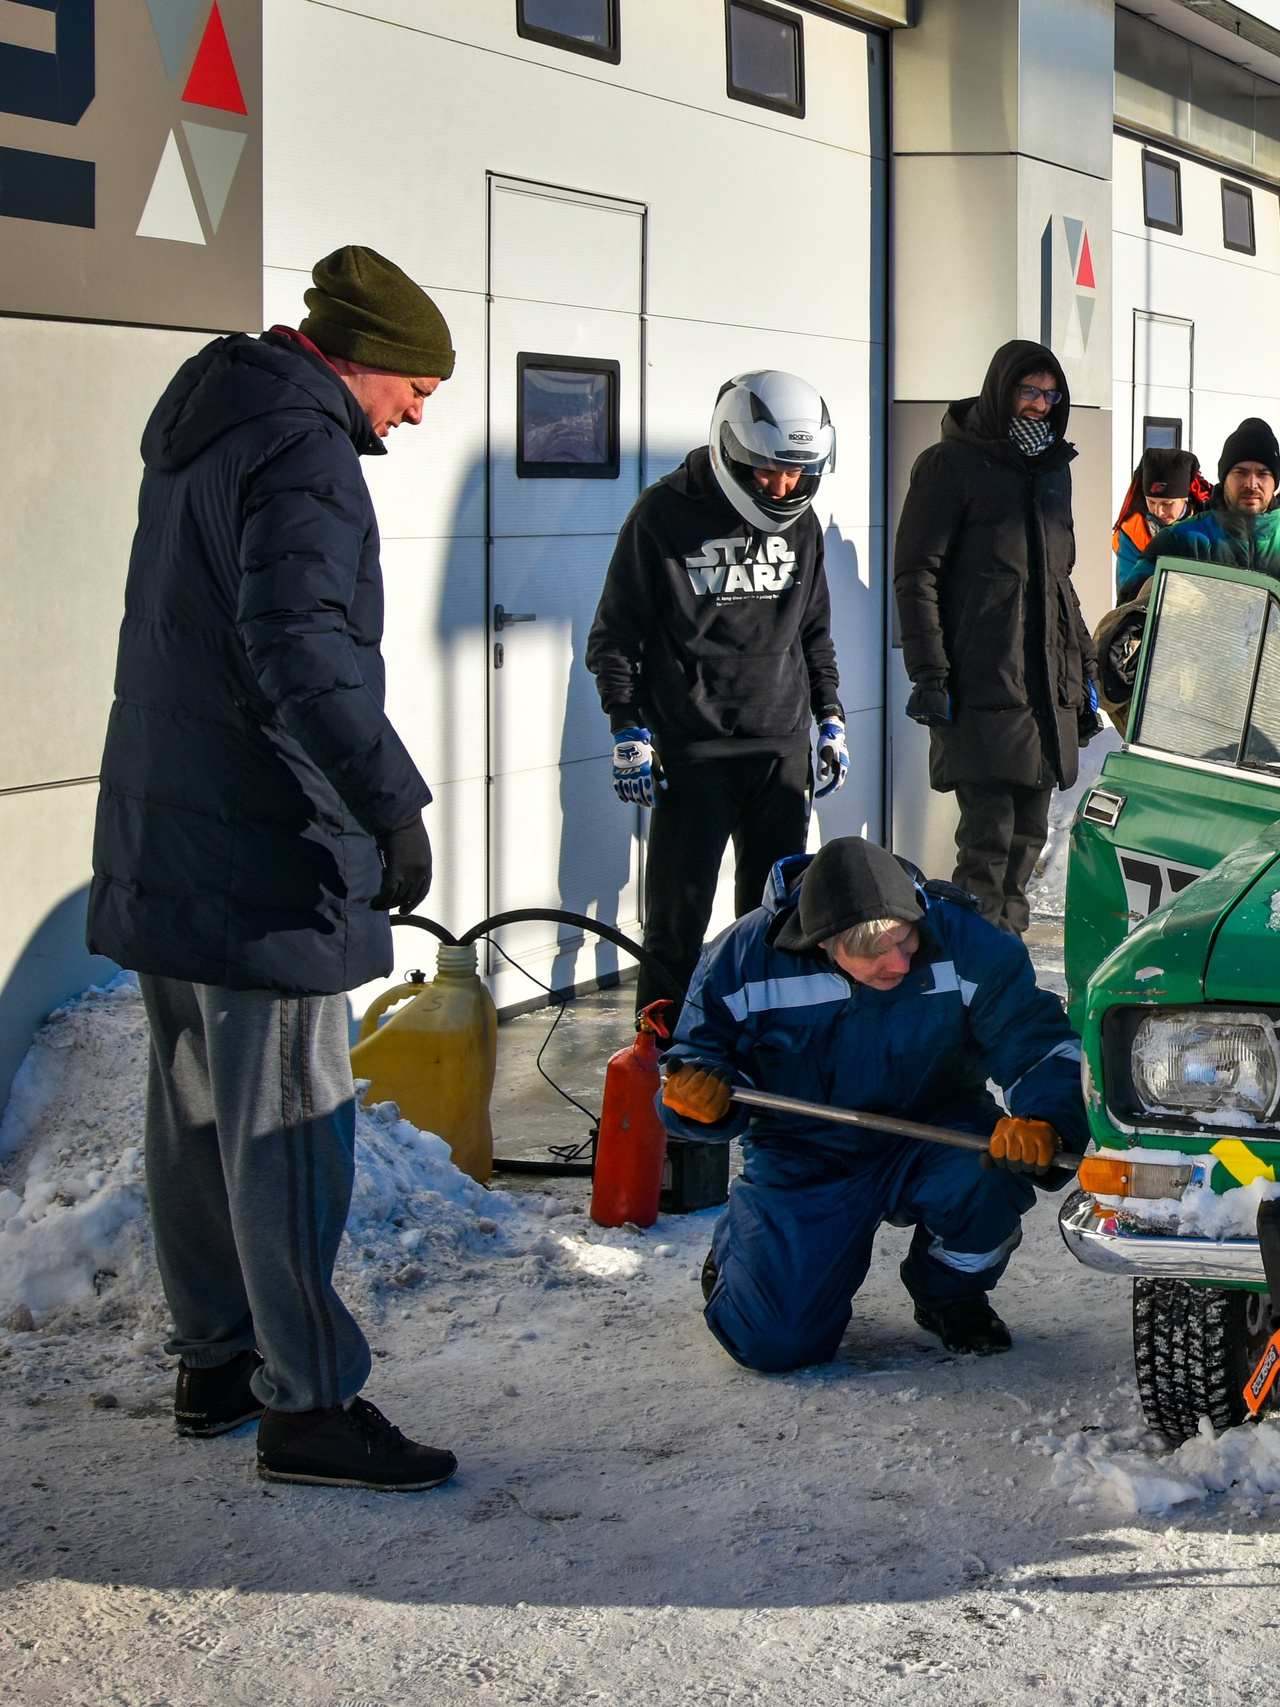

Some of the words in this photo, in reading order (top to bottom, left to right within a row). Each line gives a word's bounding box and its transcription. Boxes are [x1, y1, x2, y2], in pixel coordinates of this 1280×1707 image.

[686, 536, 796, 568] STAR
[687, 562, 799, 595] WARS
[1251, 1345, 1277, 1396] sparco
